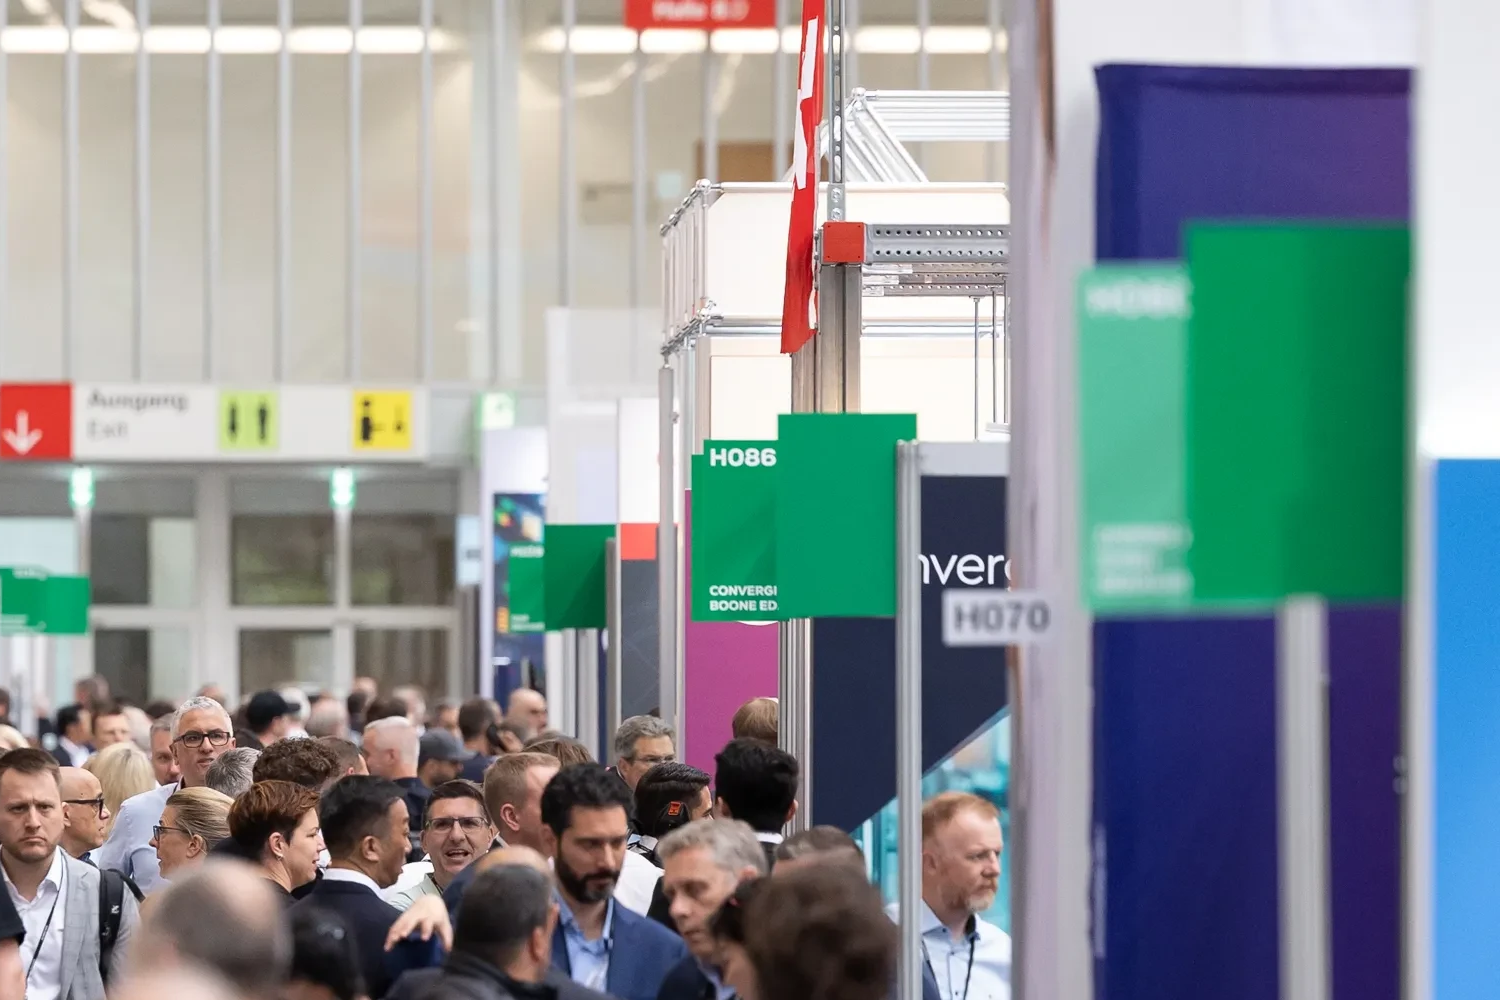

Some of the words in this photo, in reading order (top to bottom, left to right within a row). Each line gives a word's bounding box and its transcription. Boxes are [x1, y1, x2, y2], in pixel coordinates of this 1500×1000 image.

[709, 447, 777, 467] H086
[918, 553, 1014, 590] nver
[709, 600, 757, 611] BOONE
[759, 600, 779, 611] ED
[954, 600, 1050, 633] H070
